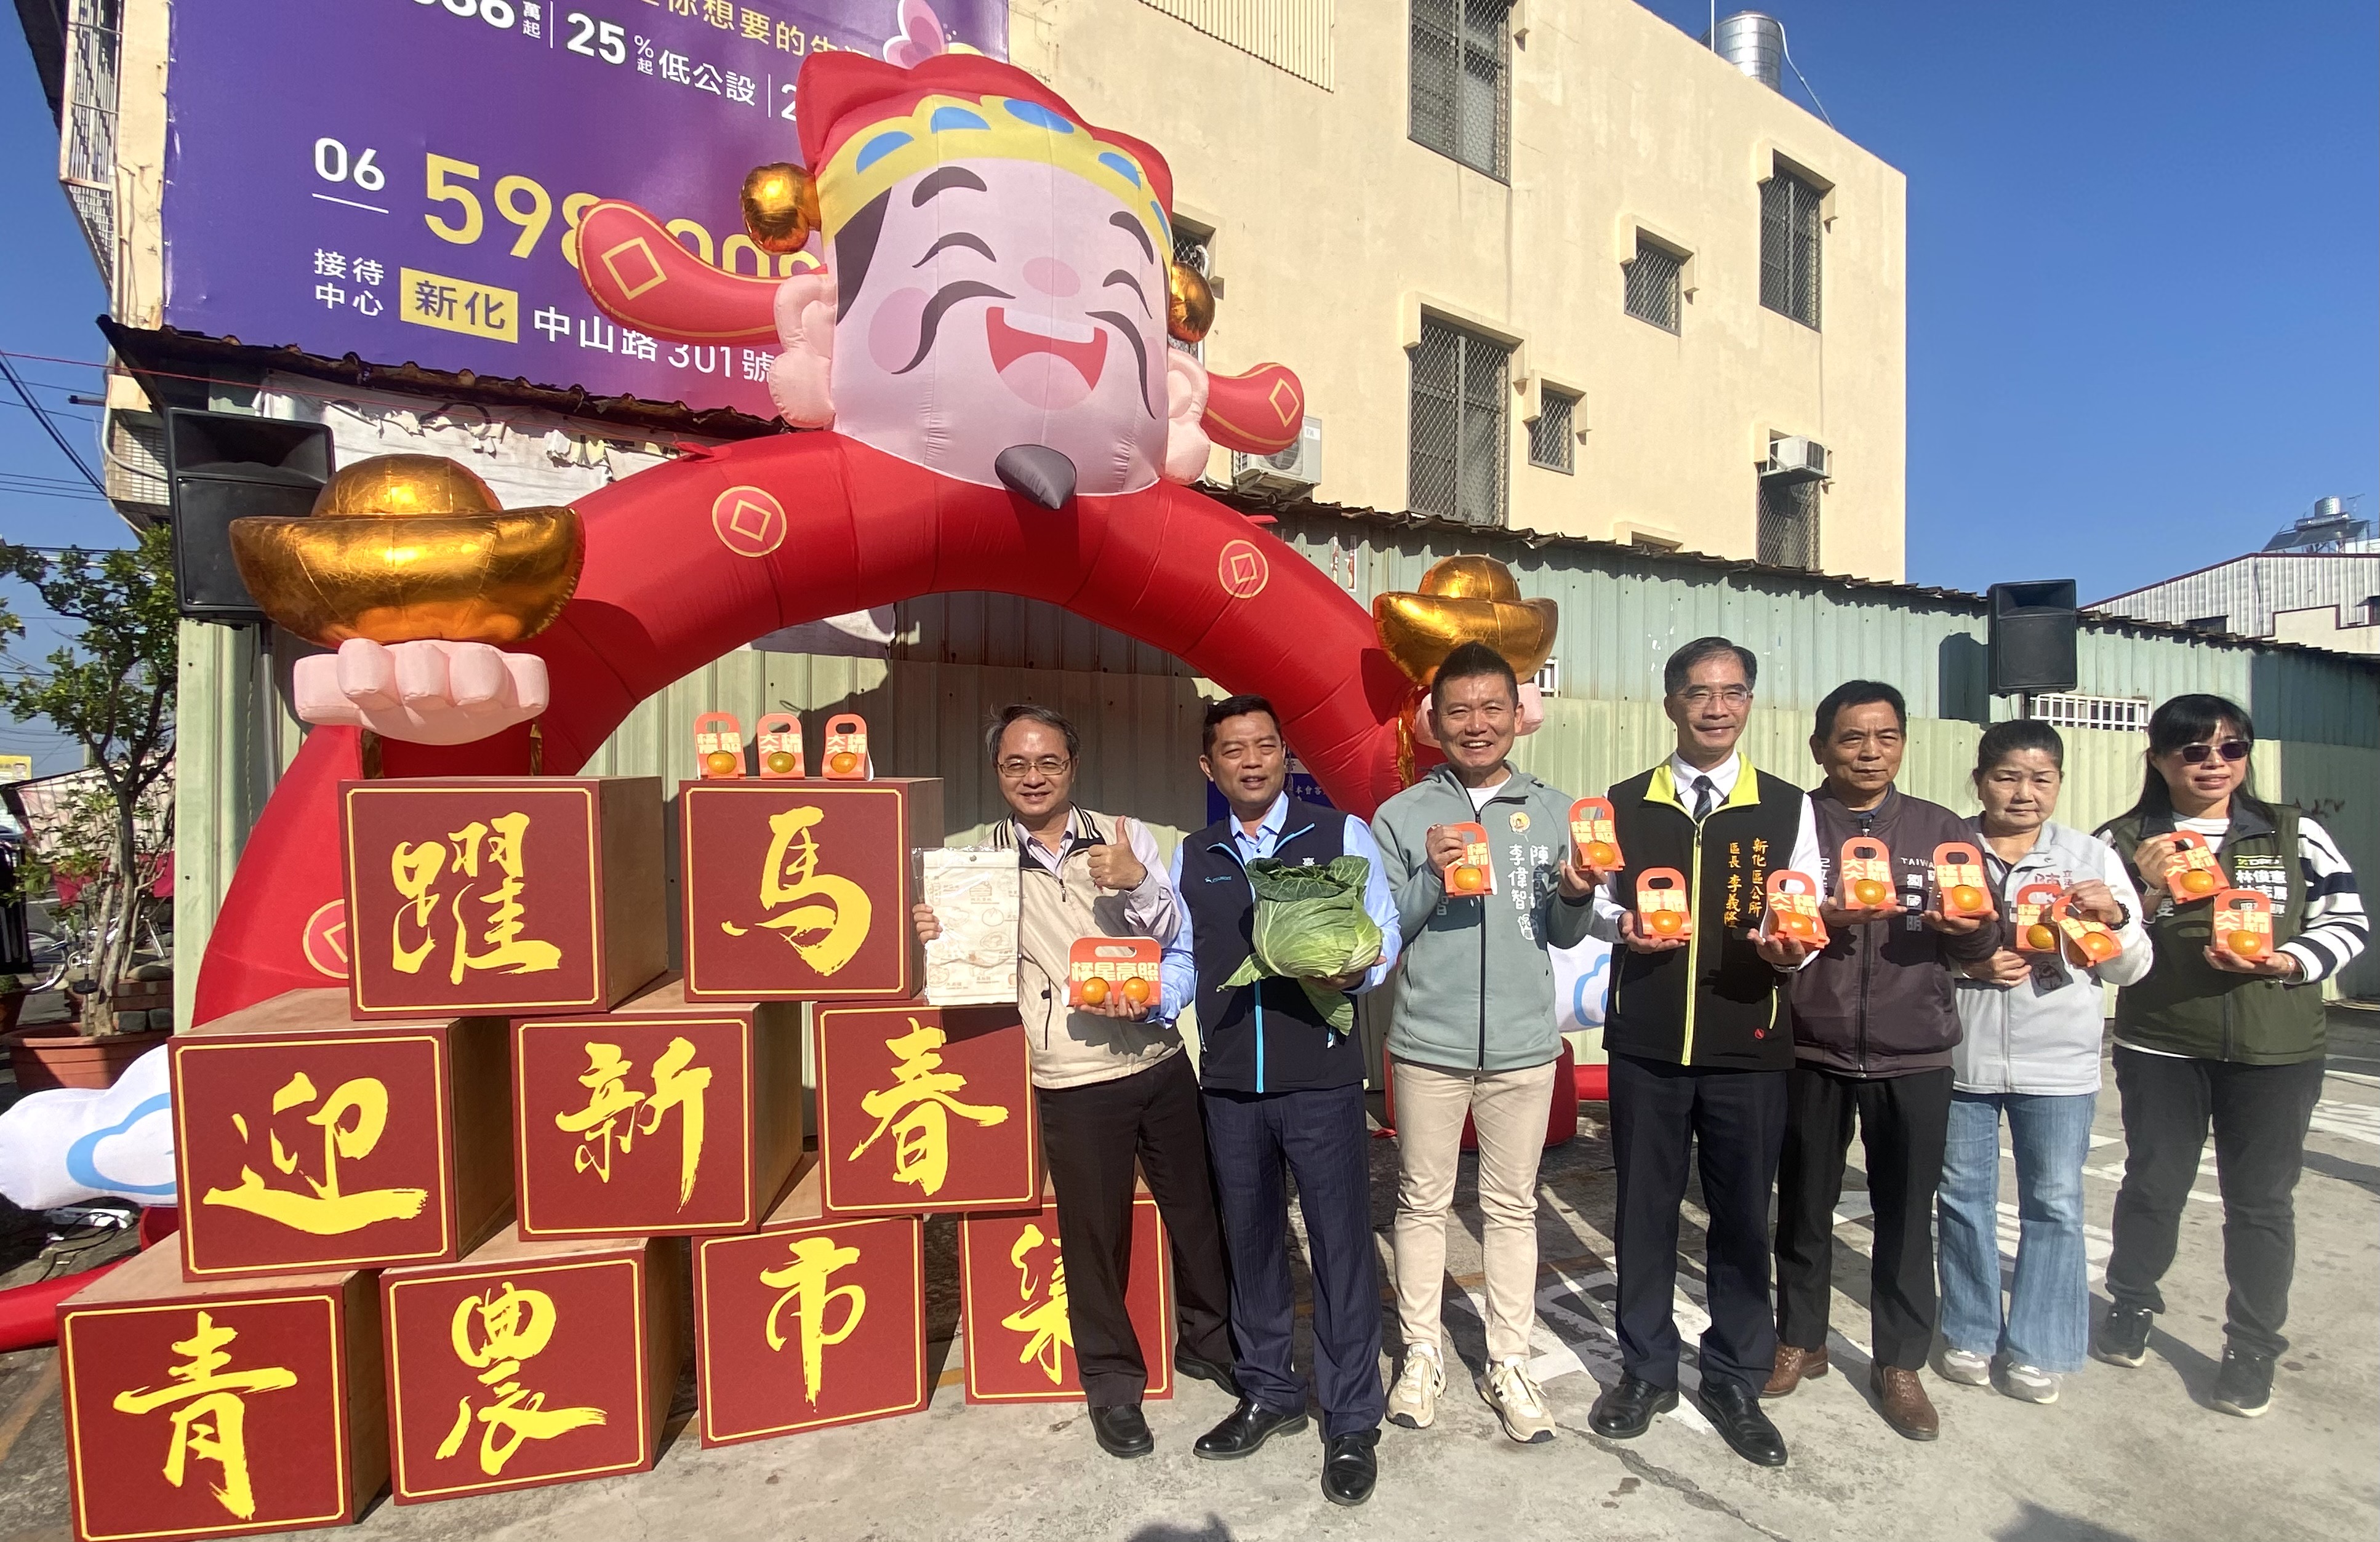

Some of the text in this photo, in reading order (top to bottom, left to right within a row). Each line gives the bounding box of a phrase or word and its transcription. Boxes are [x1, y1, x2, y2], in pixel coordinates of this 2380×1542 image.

[566, 12, 627, 65] 25
[659, 49, 756, 106] 低公設
[314, 137, 386, 191] 06
[314, 249, 384, 286] 接待
[314, 282, 384, 317] 中心
[415, 280, 505, 330] 新化
[722, 806, 871, 977] 馬
[1507, 844, 1528, 910] 李偉智
[1748, 837, 1769, 918] 新化區公所
[1900, 857, 1936, 869] TAIWA
[1071, 961, 1159, 981] 橘星高照
[204, 1017, 1008, 1234] 迎 新 春
[113, 1311, 297, 1520] 青
[436, 1282, 607, 1476] 農
[759, 1237, 866, 1412] 市
